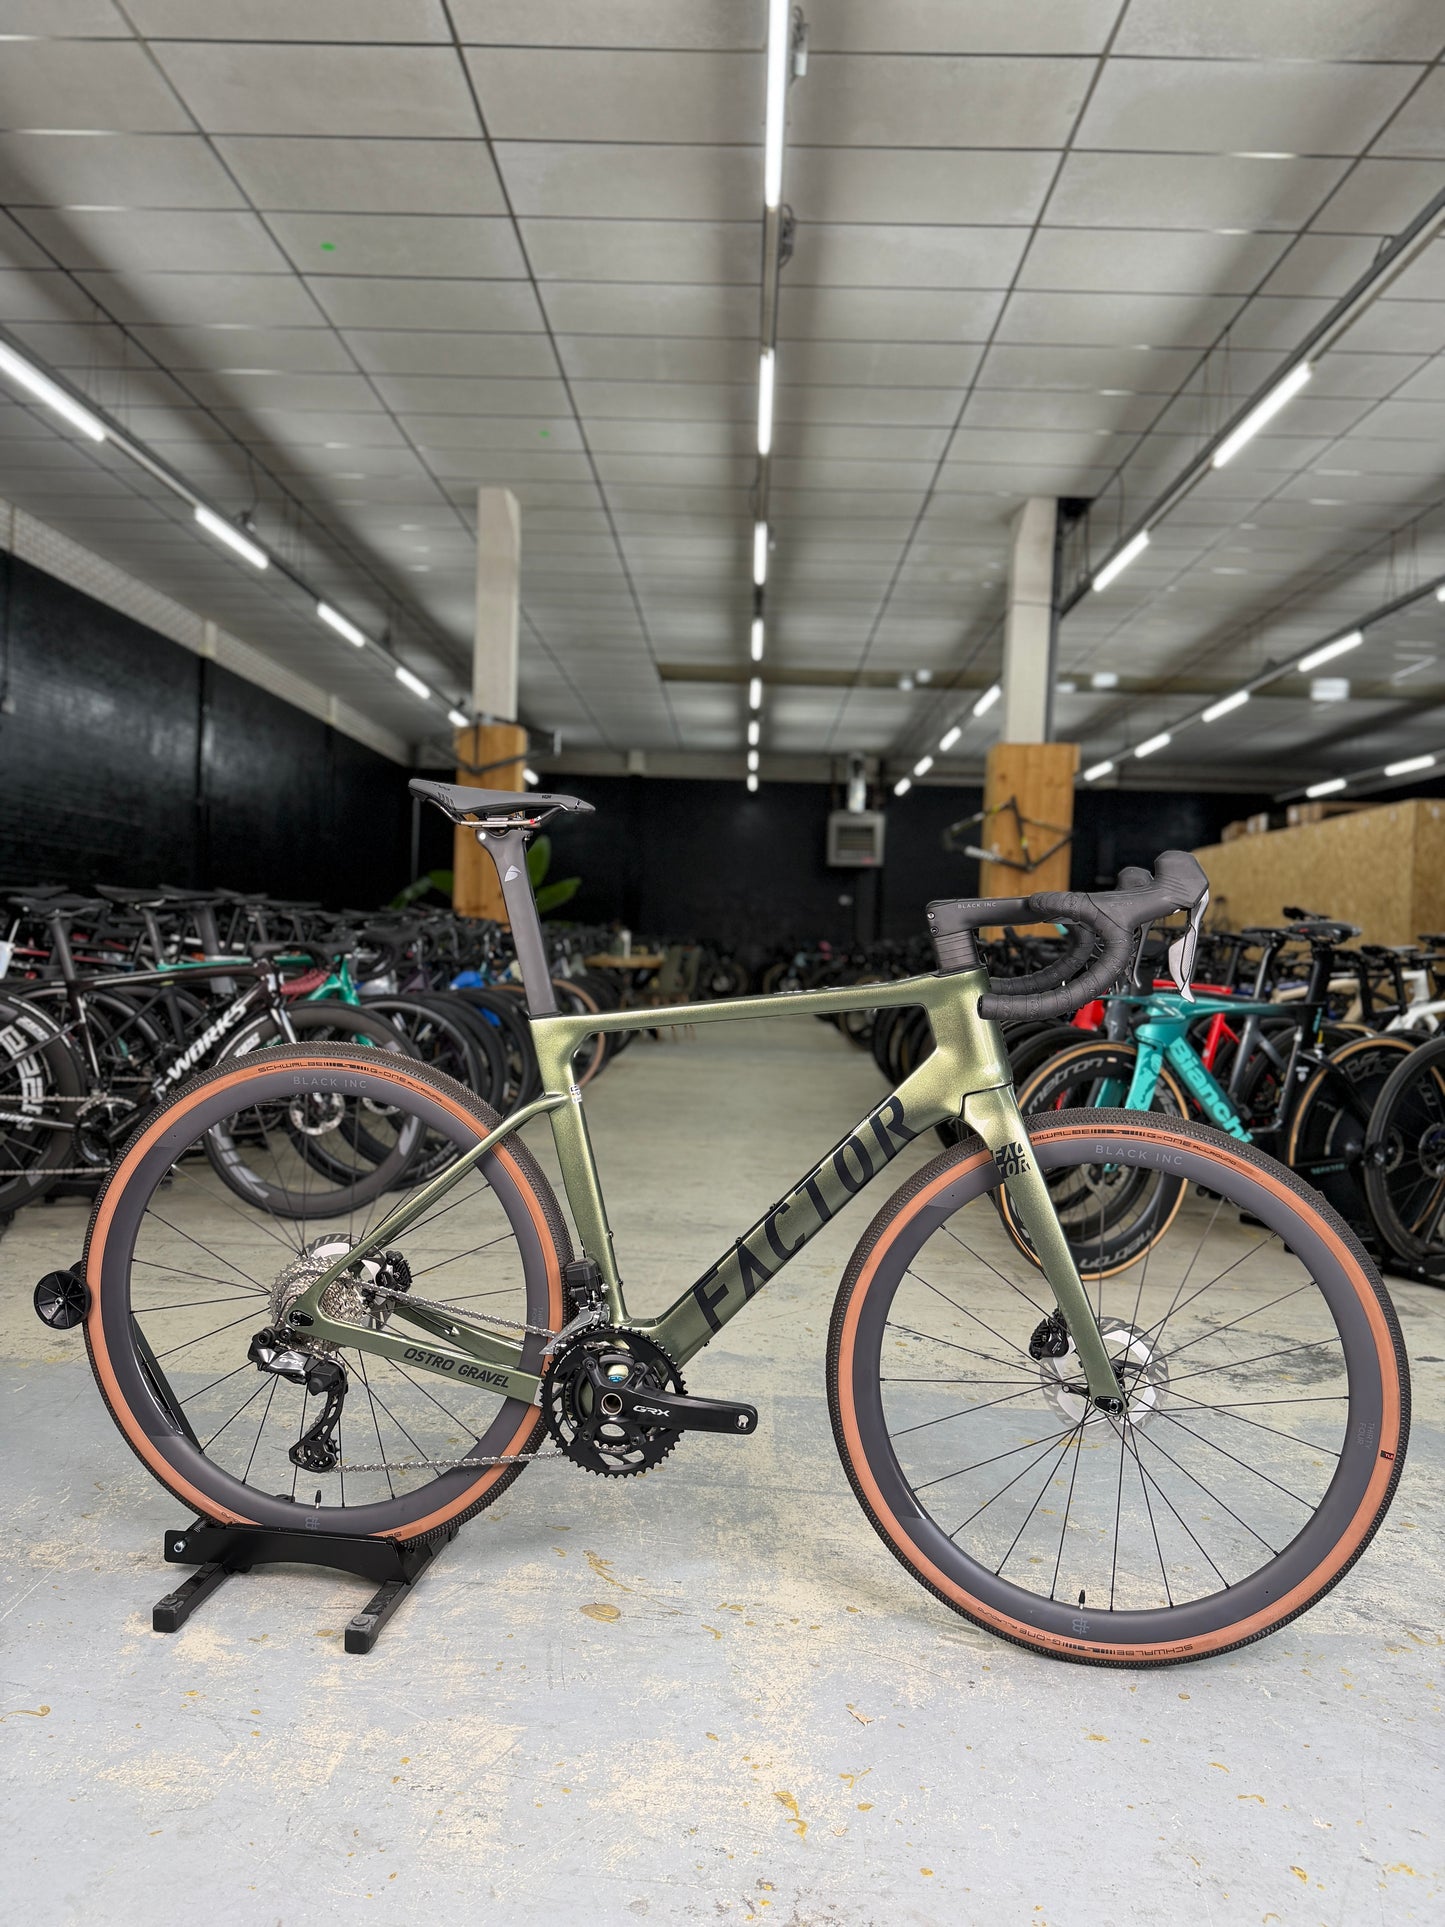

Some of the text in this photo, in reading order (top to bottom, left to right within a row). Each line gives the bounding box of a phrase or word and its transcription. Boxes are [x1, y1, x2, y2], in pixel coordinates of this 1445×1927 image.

[257, 1061, 324, 1073] SCHWALBE
[370, 1067, 407, 1083] G-ONE
[293, 1075, 367, 1089] BLACK INC
[1028, 1057, 1104, 1115] metron
[1169, 1036, 1254, 1142] Bianchi
[1031, 1129, 1237, 1166] HWALBE G-ONE ALLROUND
[1095, 1144, 1184, 1166] BLACK INC
[693, 1095, 920, 1335] FACTOR
[404, 1347, 510, 1389] OSTRO GRAVEL
[633, 1404, 670, 1417] GRX
[1018, 1628, 1062, 1646] G-ONE
[1116, 1643, 1194, 1657] SCHWALBE
